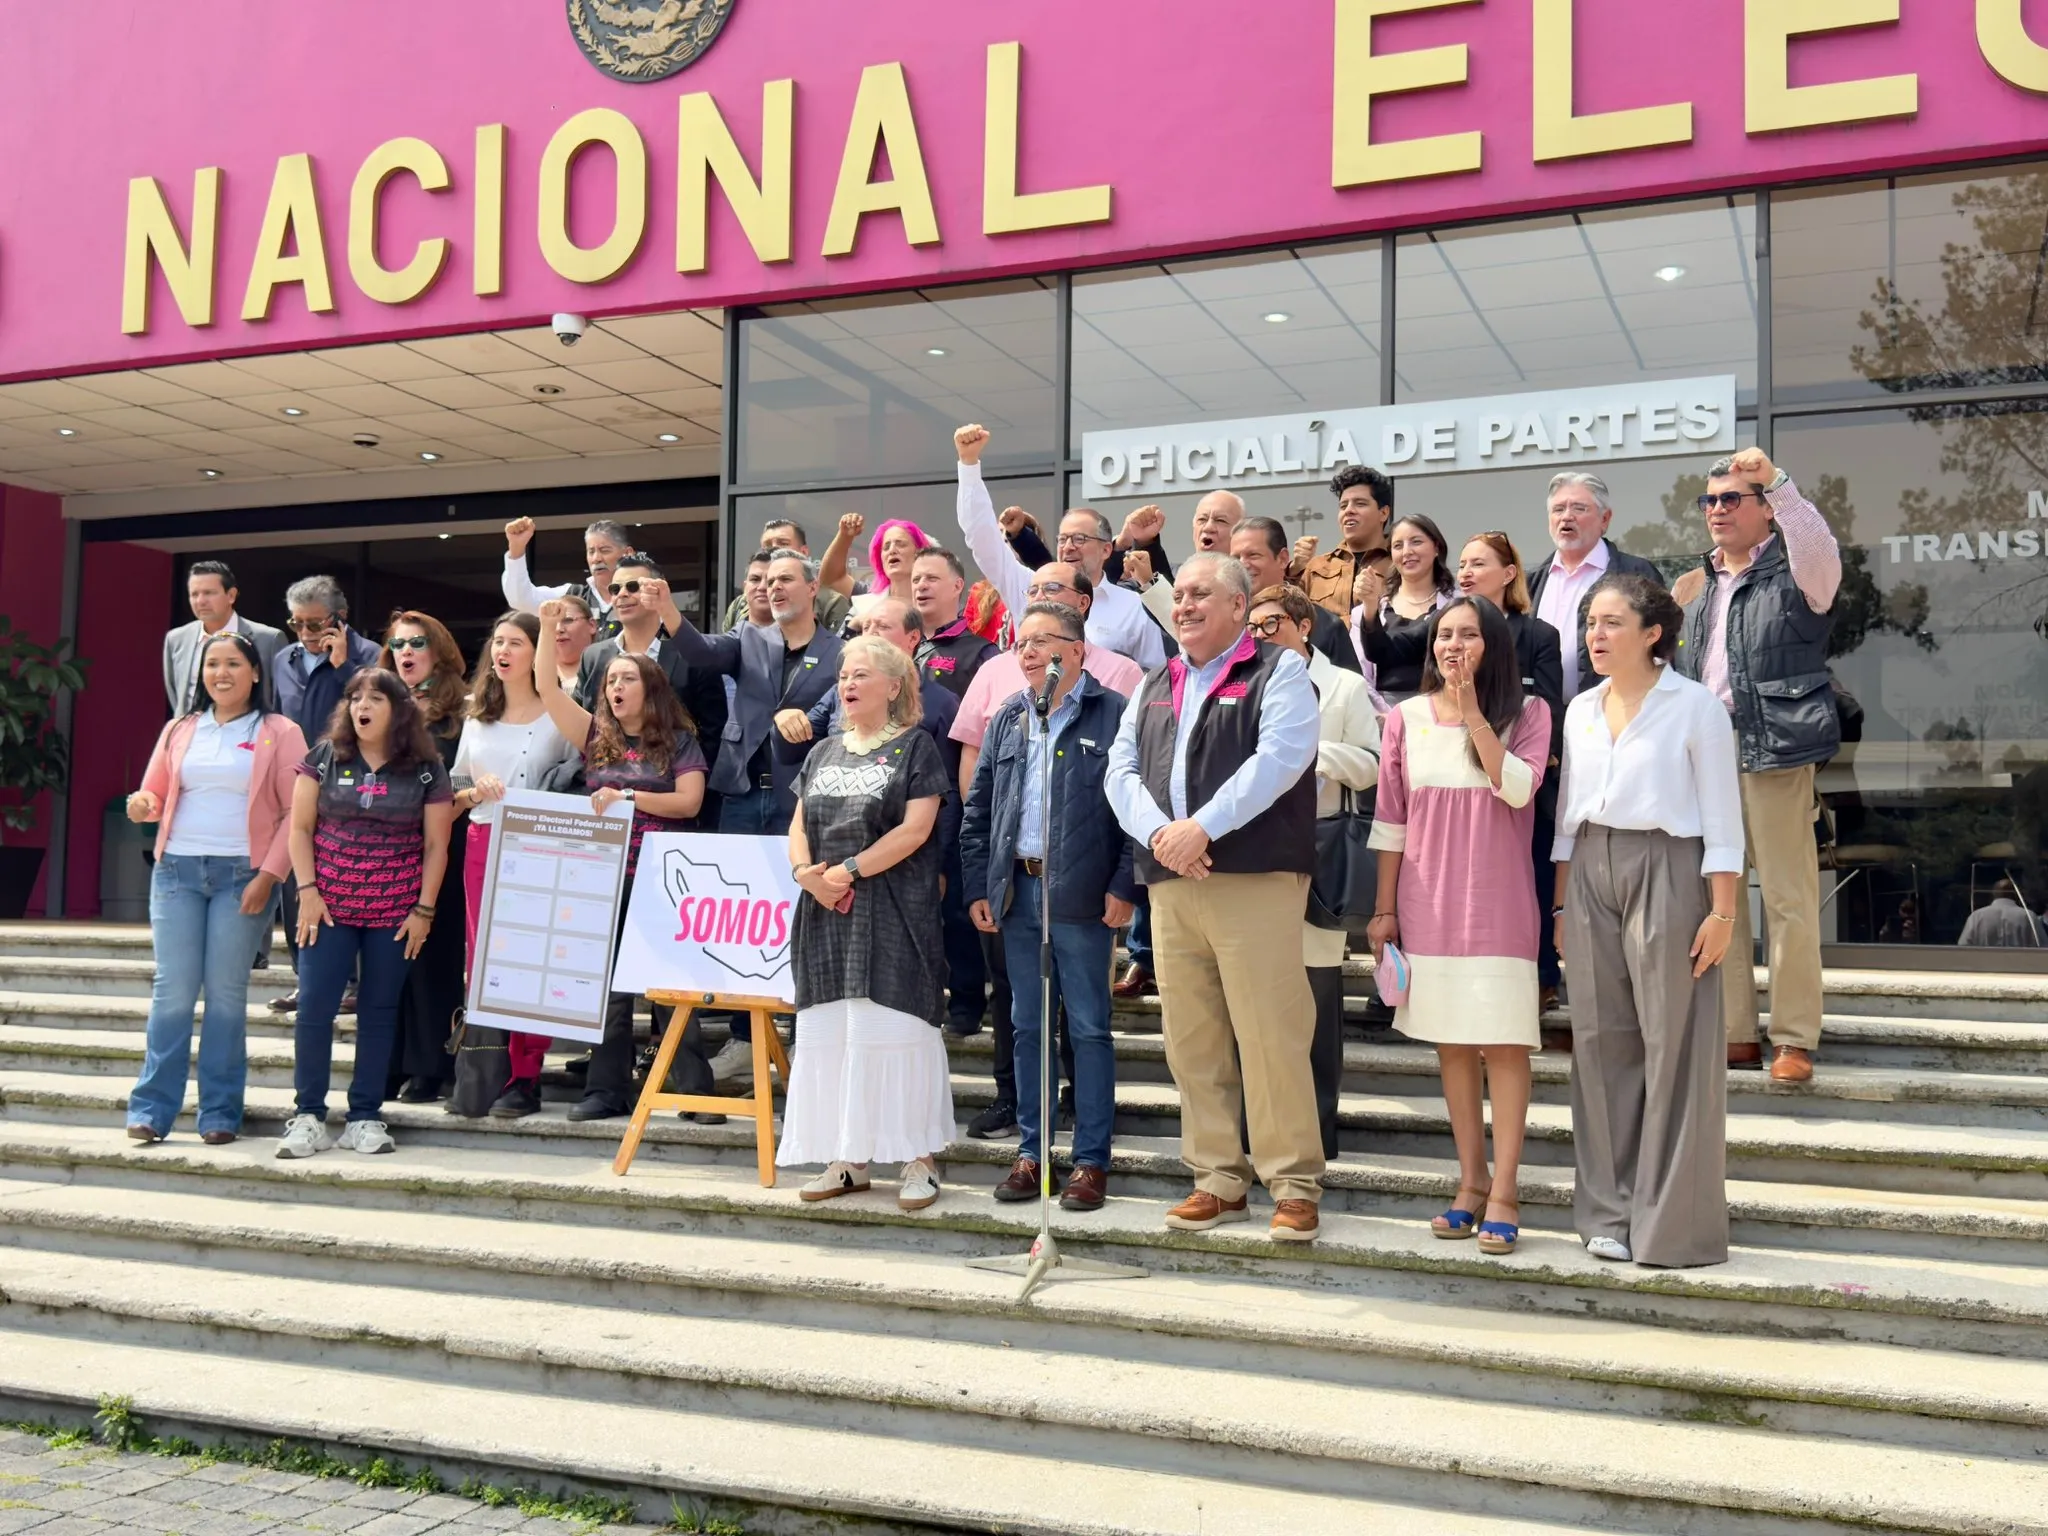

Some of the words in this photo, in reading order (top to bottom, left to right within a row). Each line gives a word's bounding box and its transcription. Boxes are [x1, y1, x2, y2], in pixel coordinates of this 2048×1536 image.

[121, 42, 1113, 335] NACIONAL
[1331, 0, 2048, 189] ELE
[1090, 420, 1364, 487] OFICIALÍA
[1382, 419, 1457, 465] DE
[1478, 401, 1721, 457] PARTES
[1881, 529, 2048, 563] TRANS
[506, 811, 537, 821] Proceso
[538, 815, 573, 826] Electoral
[574, 819, 603, 829] Federal
[604, 822, 624, 831] 2027
[548, 825, 593, 837] LLEGAMOS!
[674, 896, 790, 947] SOMOS
